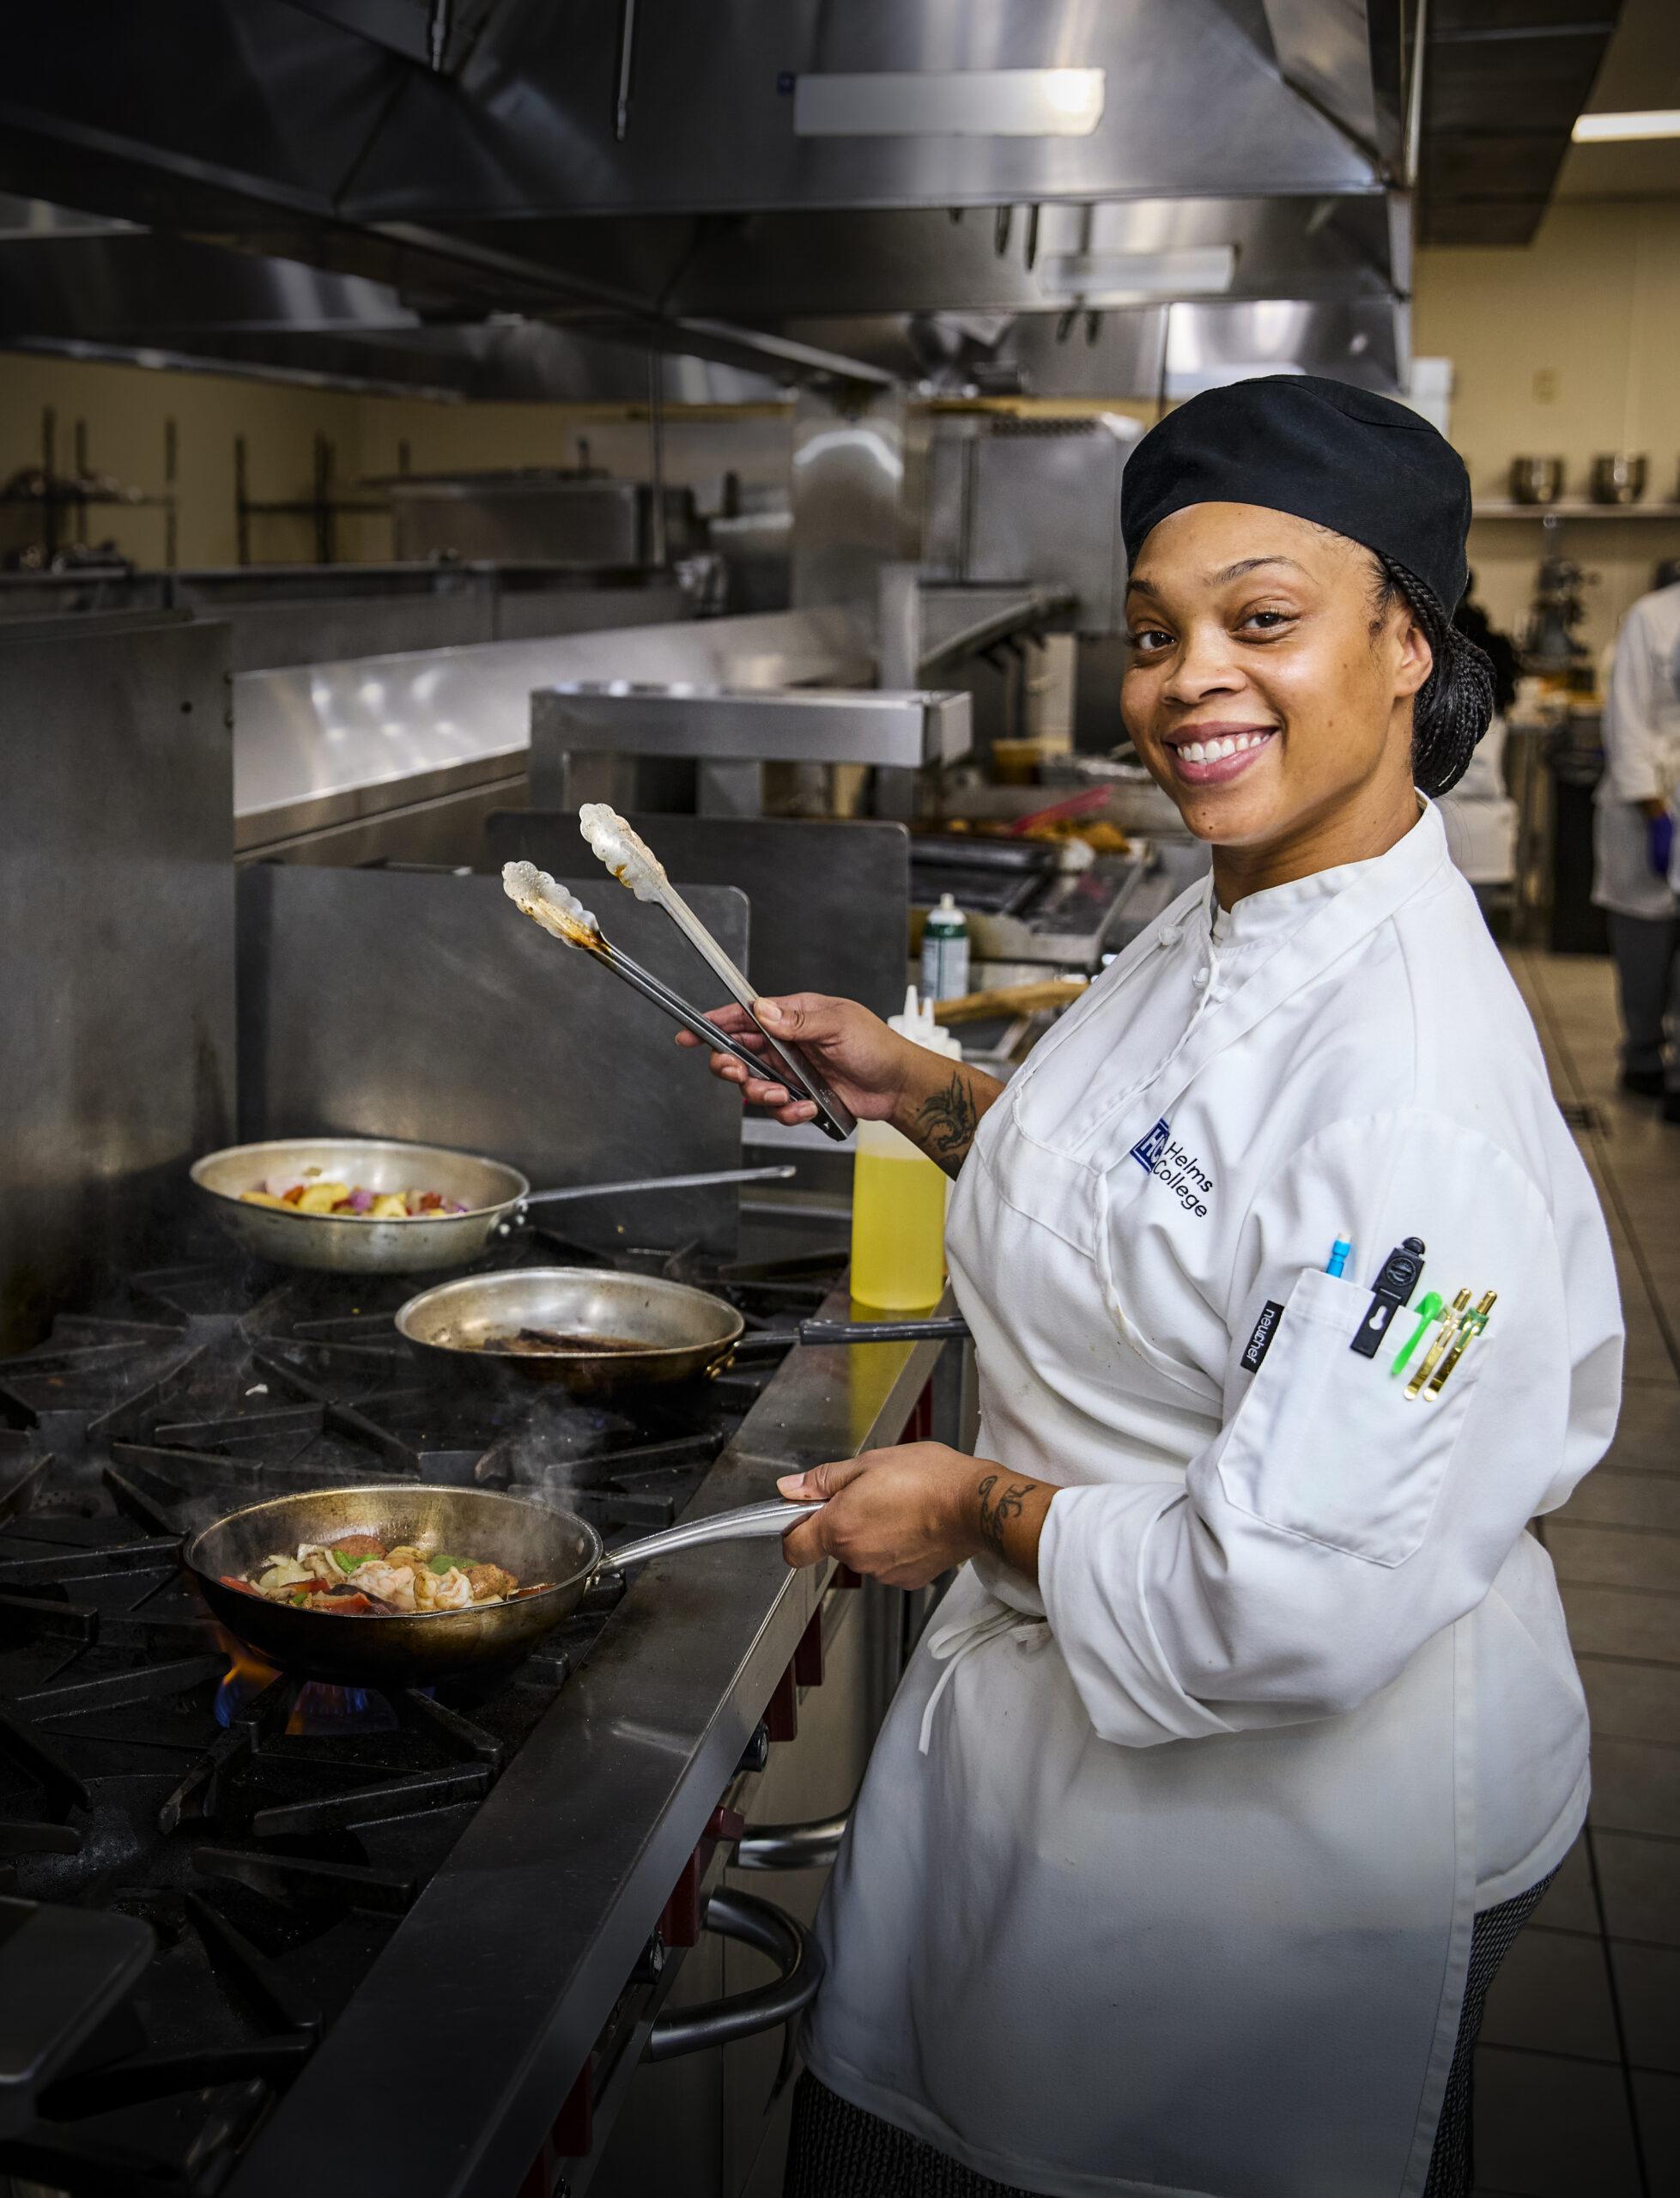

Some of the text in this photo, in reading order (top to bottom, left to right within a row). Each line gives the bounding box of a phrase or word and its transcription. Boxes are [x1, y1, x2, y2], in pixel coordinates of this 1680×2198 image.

[1153, 1159, 1208, 1217] College
[1164, 1141, 1213, 1193] Helms
[1246, 1308, 1276, 1363] neuchef
